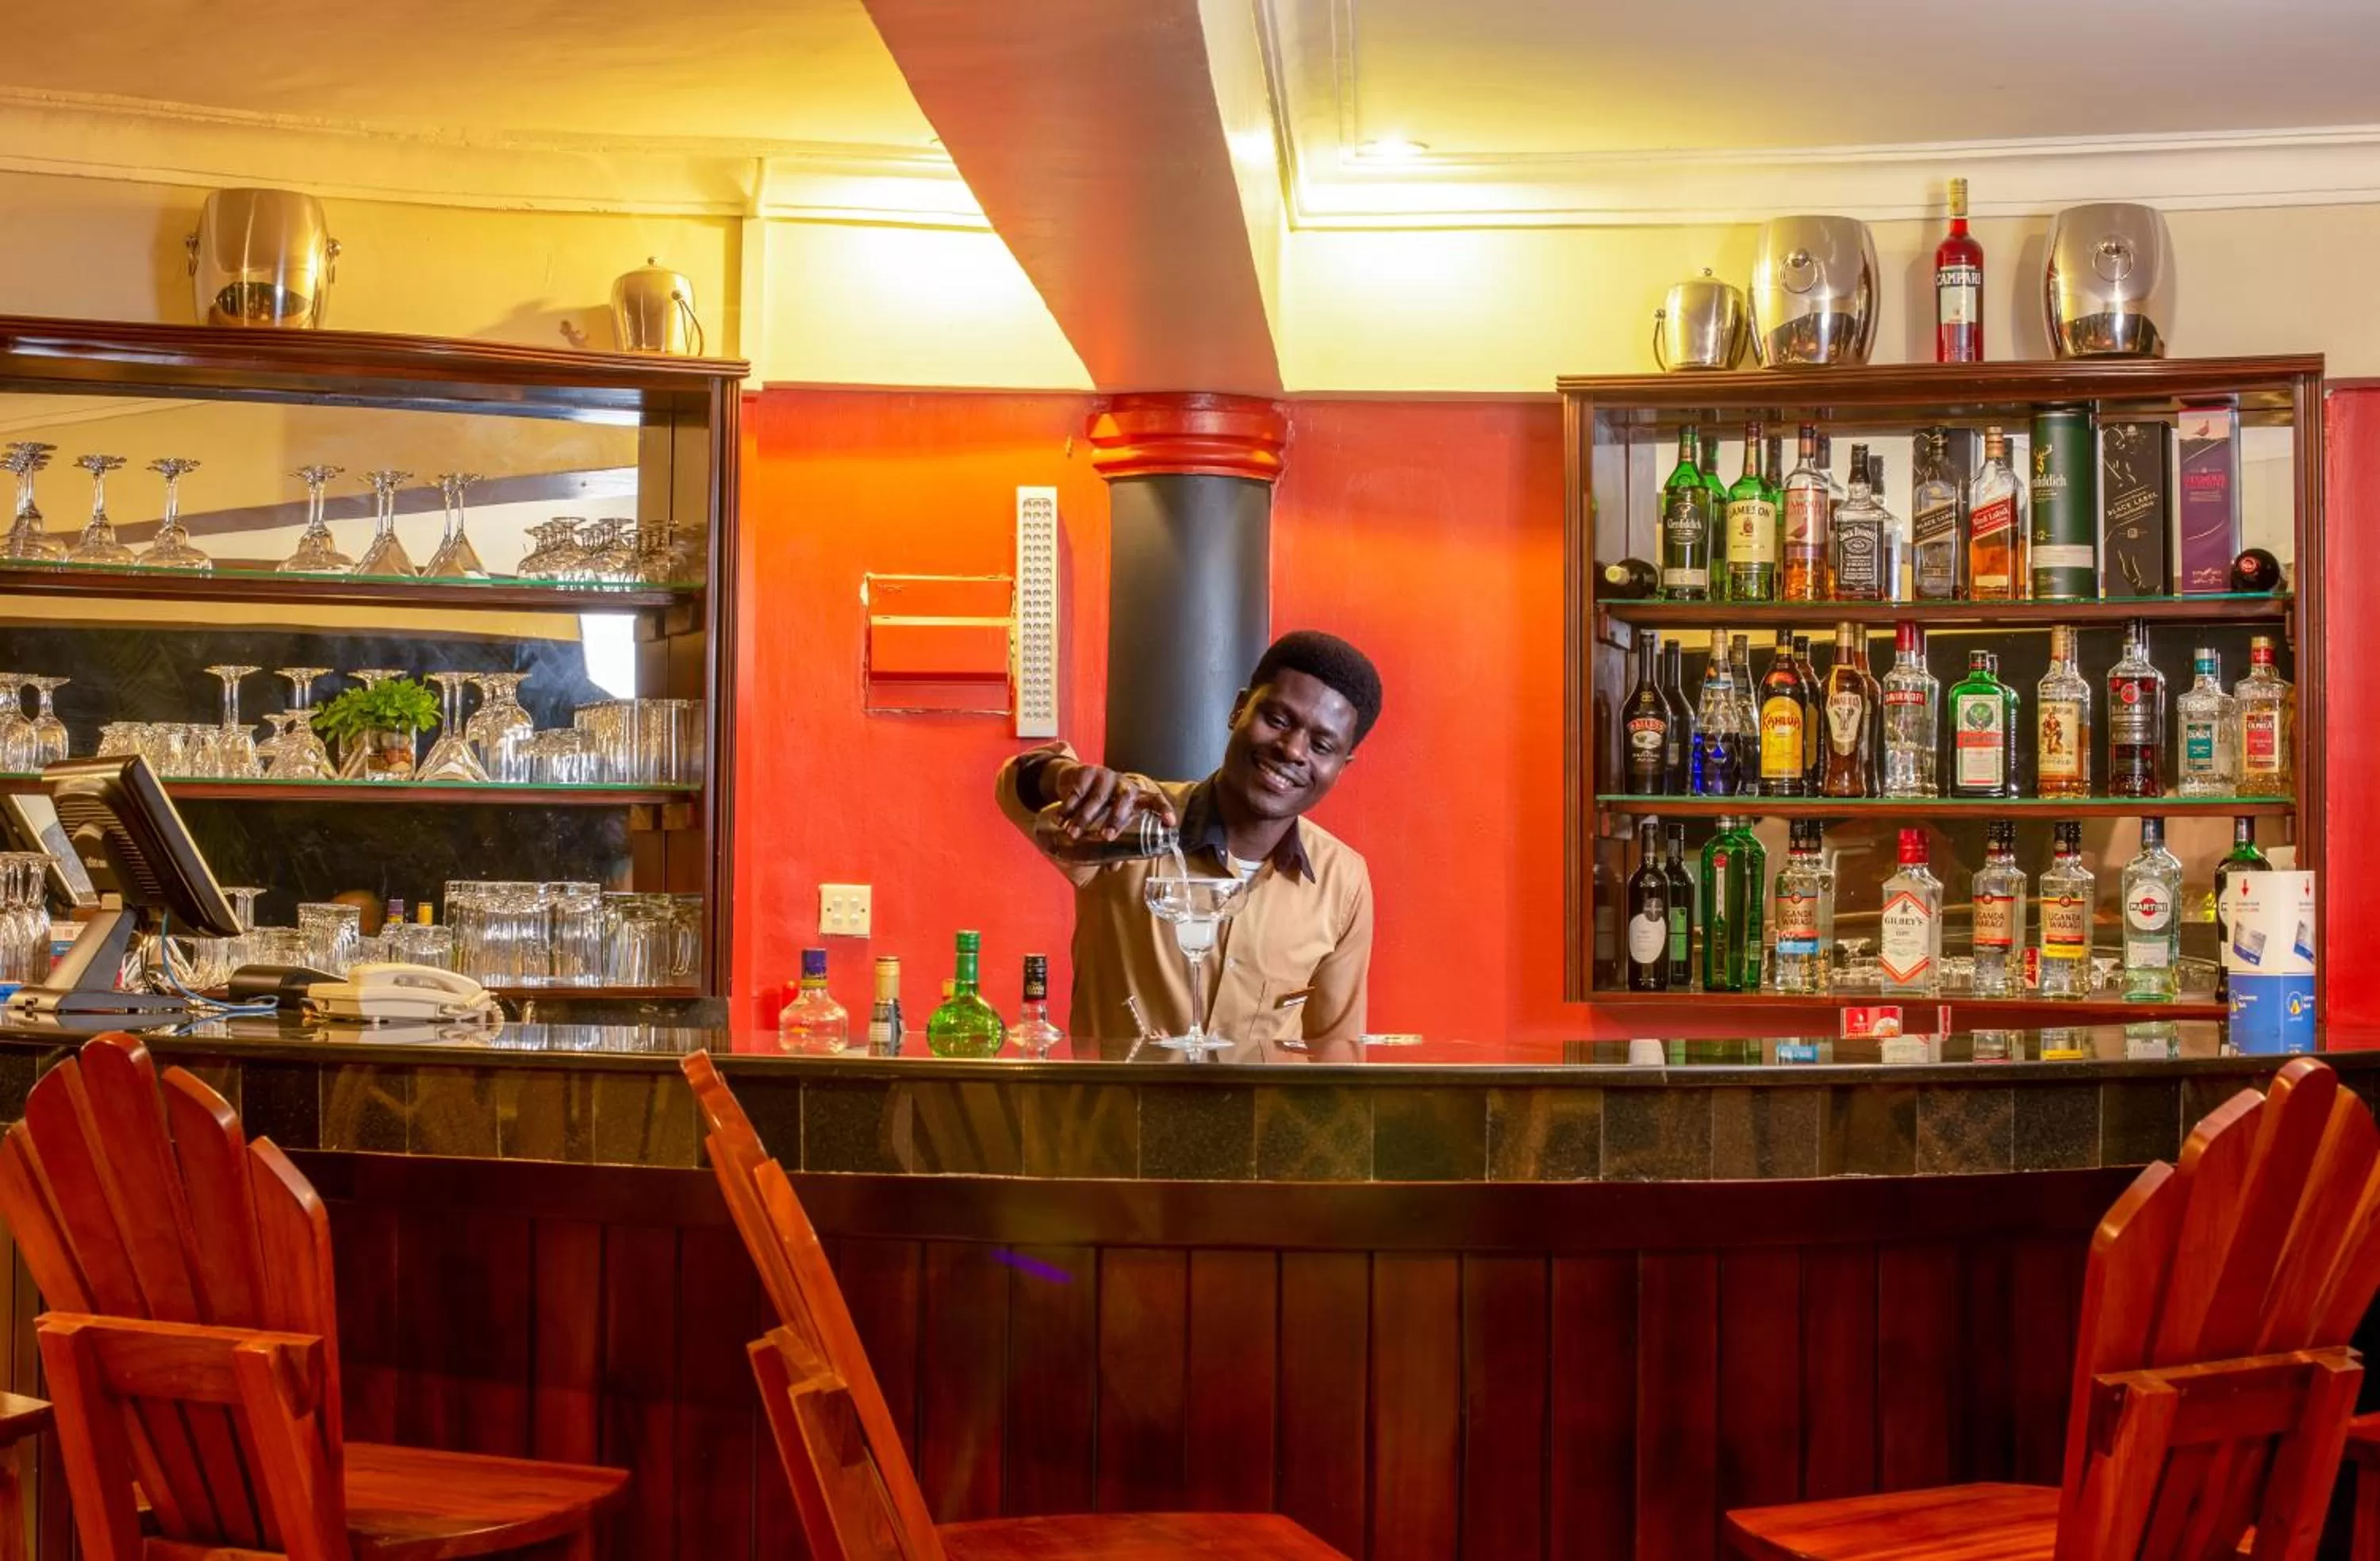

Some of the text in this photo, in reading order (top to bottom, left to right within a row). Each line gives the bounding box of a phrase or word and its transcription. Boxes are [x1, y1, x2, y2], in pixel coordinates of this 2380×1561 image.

[1936, 272, 1981, 286] CAMPARI
[1729, 505, 1770, 519] JAMESON
[2130, 903, 2167, 912] MARTINI
